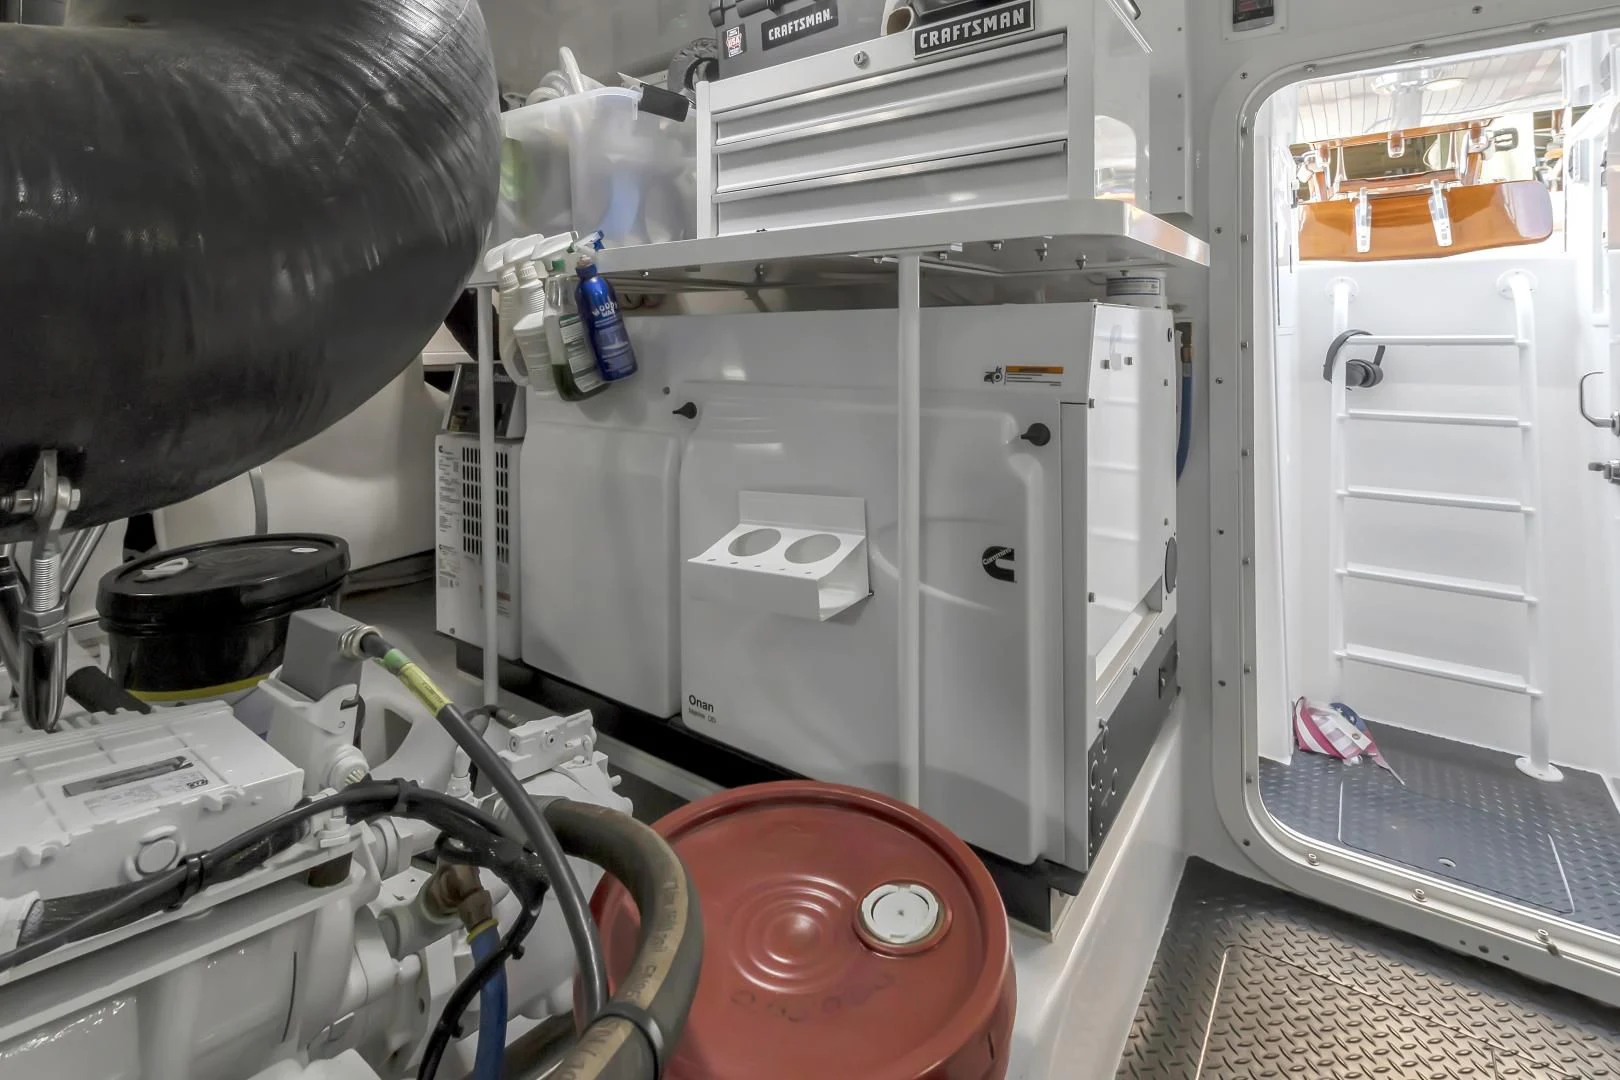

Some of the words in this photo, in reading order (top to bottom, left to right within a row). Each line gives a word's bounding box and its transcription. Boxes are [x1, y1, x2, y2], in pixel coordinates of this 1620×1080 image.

[769, 8, 830, 40] CRAFTSMAN
[920, 8, 1024, 48] CRAFTSMAN
[689, 695, 714, 713] Onan
